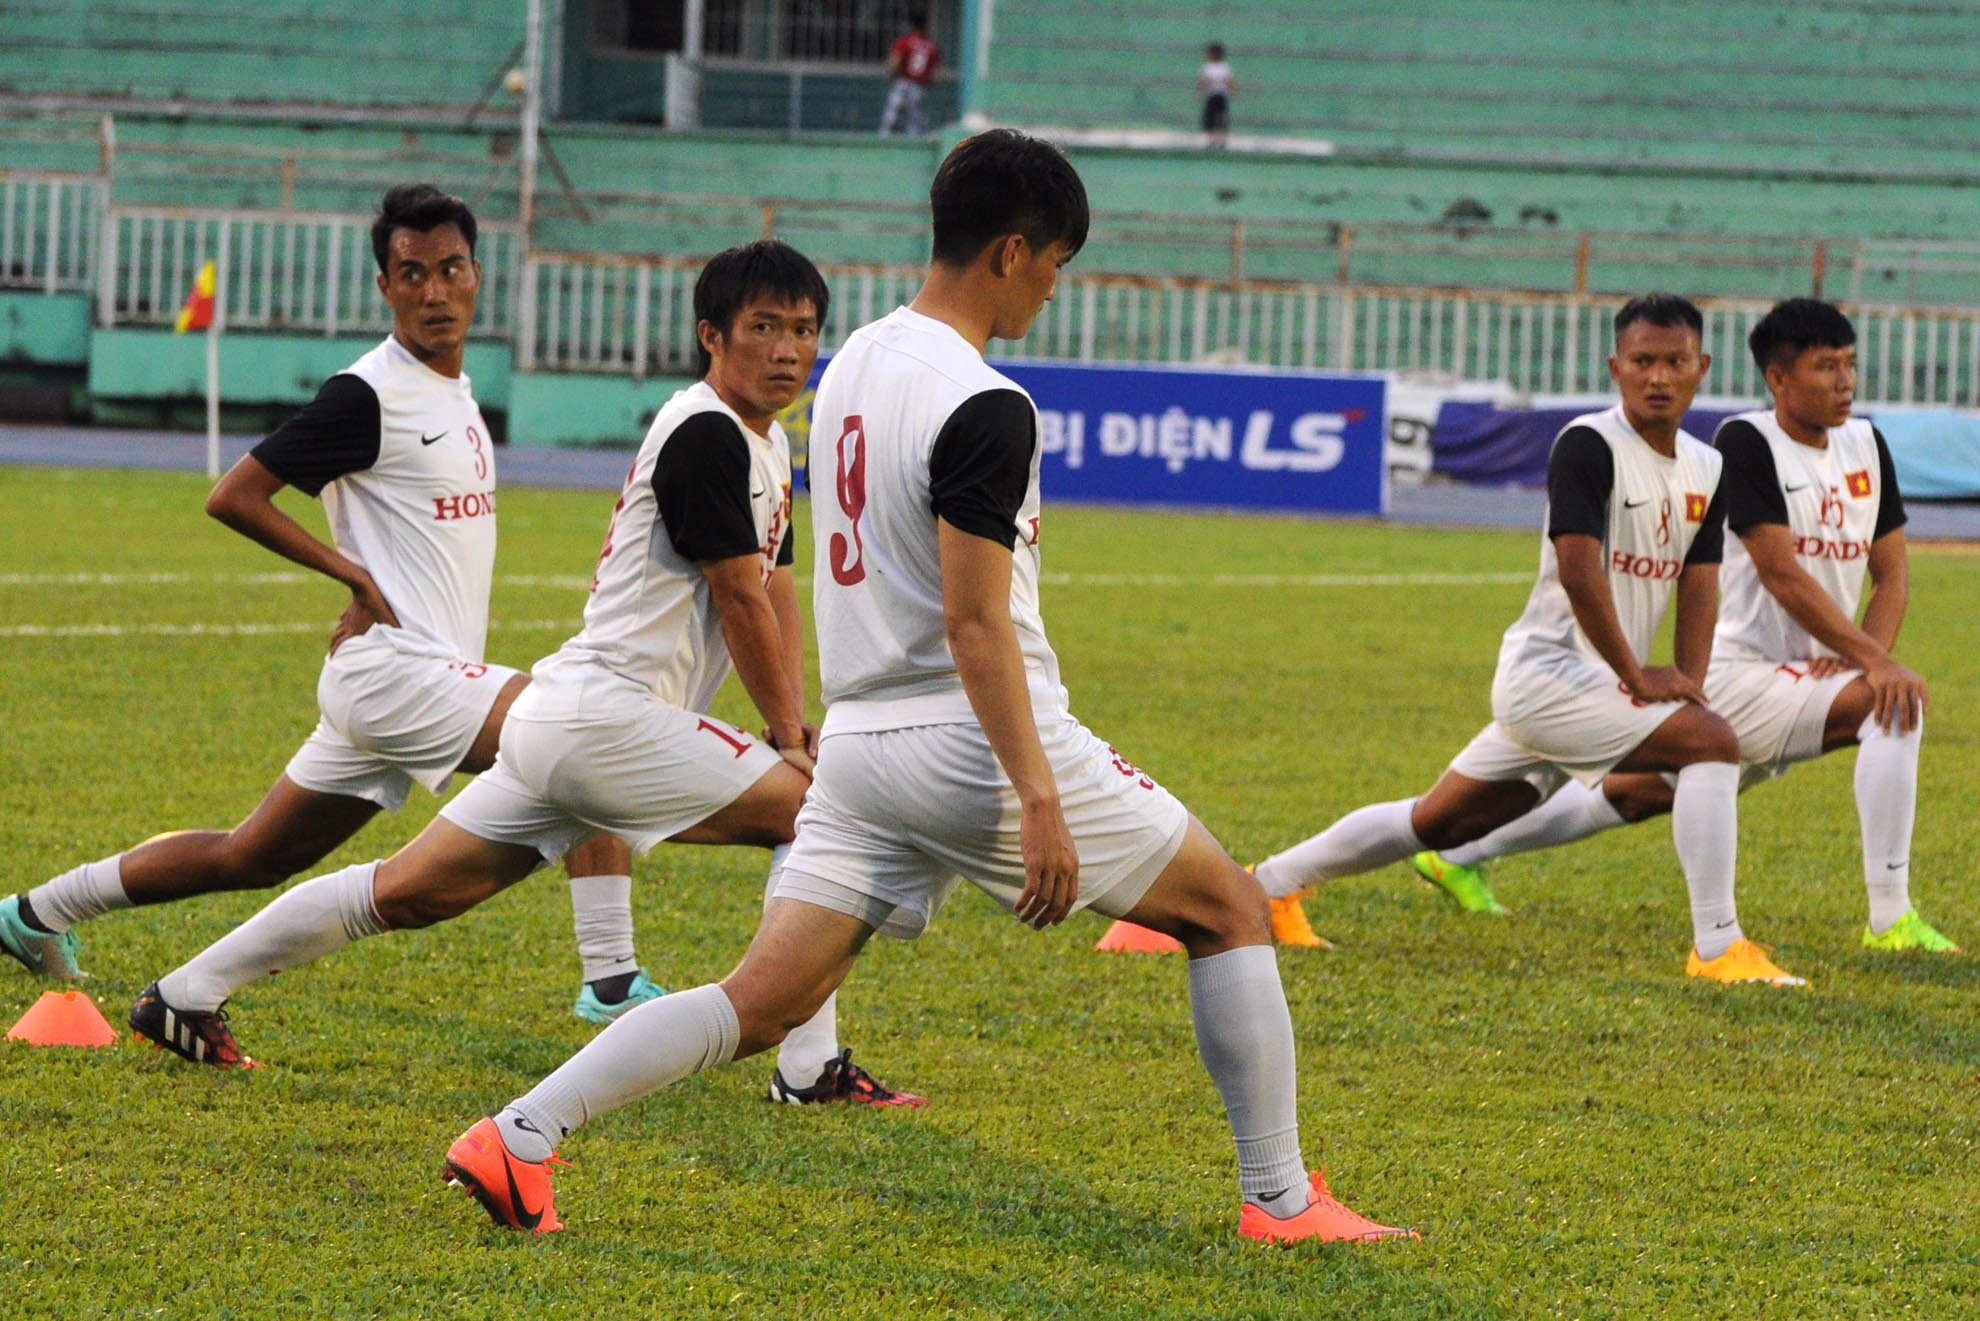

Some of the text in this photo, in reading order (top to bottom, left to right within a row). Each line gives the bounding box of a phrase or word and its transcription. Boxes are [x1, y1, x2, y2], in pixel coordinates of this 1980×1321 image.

[466, 425, 487, 480] 3
[1098, 405, 1233, 474] ĐIỆN
[1239, 409, 1349, 473] LS
[830, 415, 866, 586] 9
[1656, 498, 1671, 550] 8
[1818, 485, 1845, 530] 15
